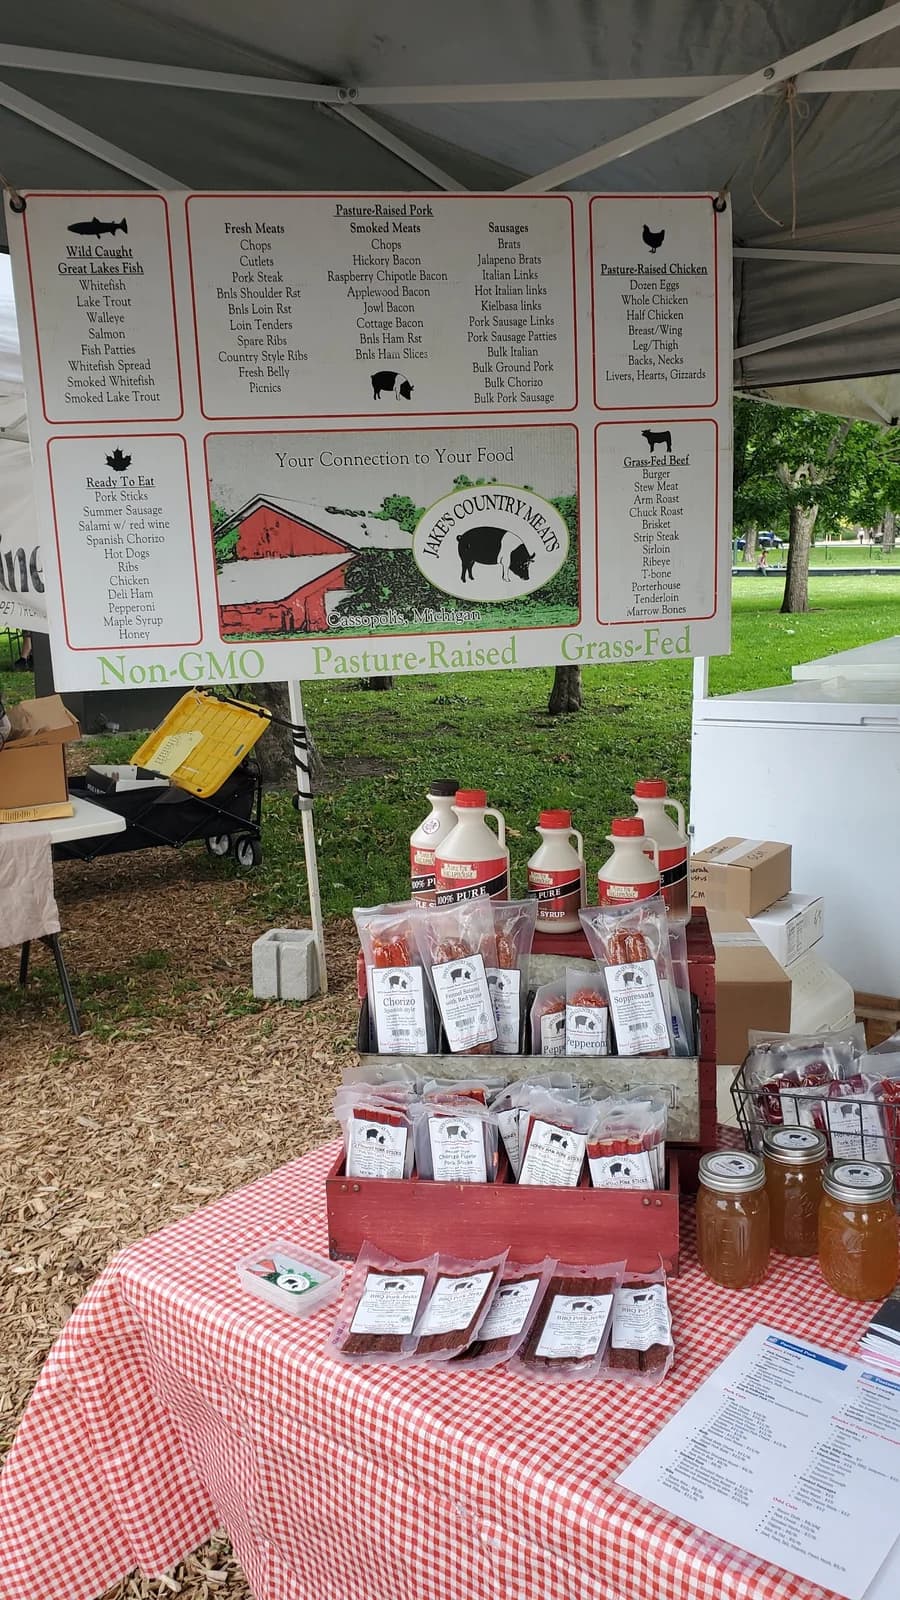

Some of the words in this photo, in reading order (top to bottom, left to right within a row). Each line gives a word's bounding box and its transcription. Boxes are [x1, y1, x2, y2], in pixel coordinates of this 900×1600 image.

[336, 204, 407, 216] Pasture-Raised
[409, 204, 433, 216] Pork
[224, 222, 252, 234] Fresh
[255, 222, 285, 234] Meats
[350, 221, 390, 234] Smoked
[392, 222, 421, 233] Meats
[488, 221, 529, 235] Sausages
[240, 238, 272, 254] Chops
[371, 238, 402, 253] Chops
[498, 238, 521, 249] Brats
[66, 246, 92, 258] Wild
[94, 245, 133, 259] Caught
[239, 255, 274, 267] Cutlets
[477, 253, 516, 268] Jalapeno
[518, 253, 542, 264] Brats
[58, 262, 88, 274] Great
[90, 262, 119, 274] Lakes
[121, 261, 144, 273] Fish
[600, 264, 667, 274] Pasture-Raised
[669, 263, 708, 274] Chicken
[232, 271, 254, 284] Pork
[257, 270, 284, 283] Steak
[327, 270, 374, 285] Raspberry
[376, 269, 417, 284] Chipotle
[419, 269, 448, 281] Bacon
[482, 268, 511, 281] Italian
[513, 268, 538, 280] Links
[78, 278, 126, 291] Whitefish
[630, 279, 658, 290] Dozen
[659, 279, 680, 292] Eggs
[347, 285, 400, 300] Applewood
[402, 285, 430, 297] Bacon
[76, 295, 100, 307] Lake
[102, 295, 132, 307] Trout
[621, 294, 650, 306] Whole
[652, 294, 688, 305] Chicken
[86, 311, 125, 325] Walleye
[88, 327, 126, 340] Salmon
[467, 331, 488, 342] Pork
[491, 330, 526, 344] Sausage
[528, 330, 557, 342] Patties
[628, 324, 683, 338] Breast/Wing
[632, 338, 679, 353] Leg/Thigh
[218, 350, 259, 364] Country
[261, 350, 285, 364] Style
[287, 349, 308, 361] Ribs
[628, 354, 656, 367] Backs,
[657, 354, 684, 365] Necks
[472, 361, 494, 373] Bulk
[495, 360, 531, 373] Ground
[533, 360, 554, 372] Pork
[606, 370, 634, 382] Livers,
[636, 369, 668, 382] Hearts,
[670, 368, 706, 380] Gizzards
[249, 381, 282, 393] Picnics
[484, 376, 505, 388] Bulk
[507, 376, 544, 388] Chorizo
[64, 391, 104, 404] Smoked
[106, 391, 130, 402] Lake
[131, 390, 160, 402] Trout
[276, 452, 314, 468] Your
[319, 451, 409, 466] Connection
[415, 452, 430, 464] to
[435, 448, 471, 464] Your
[477, 446, 514, 462] Food
[623, 456, 667, 467] Grass-Fed
[668, 454, 690, 466] Beef
[642, 468, 670, 481] Burger
[86, 476, 118, 490] Ready
[120, 476, 135, 487] To
[138, 475, 154, 486] Eat
[94, 490, 118, 502] Pork
[120, 489, 148, 502] Sticks
[83, 506, 123, 517] Summer
[125, 504, 162, 517] Sausage
[629, 506, 658, 518] Chuck
[660, 506, 684, 517] Roast
[78, 520, 111, 532] Salami
[113, 520, 126, 530] w/
[129, 518, 145, 530] red
[147, 519, 170, 529] wine
[422, 512, 456, 558] JAKE'S
[453, 494, 527, 519] COUNTRY
[523, 506, 560, 553] MEATS
[642, 518, 671, 530] Brisket
[86, 533, 124, 548] Spanish
[126, 533, 165, 544] Chorizo
[633, 532, 654, 544] Strip
[656, 530, 680, 542] Steak
[104, 548, 124, 559] Hot
[125, 547, 150, 560] Dogs
[642, 543, 670, 555] Sirloin
[118, 561, 139, 572] Ribs
[642, 556, 671, 568] Ribeye
[109, 574, 150, 586] Chicken
[641, 568, 672, 579] T-bone
[632, 580, 681, 592] Porterhouse
[633, 592, 679, 604] Tenderloin
[108, 602, 156, 616] Pepperoni
[103, 615, 133, 628] Maple
[135, 614, 163, 627] Syrup
[328, 610, 409, 629] Cassopolis,
[412, 608, 481, 625] Michigan
[119, 628, 150, 640] Honey
[561, 625, 692, 661] Grass-Fed
[312, 635, 517, 674] Pasture-Raised
[96, 649, 265, 685] Non-GMO
[456, 886, 486, 902] PURE
[538, 888, 560, 900] PURE
[383, 996, 416, 1008] Chorizo
[614, 992, 655, 1004] Soppressata
